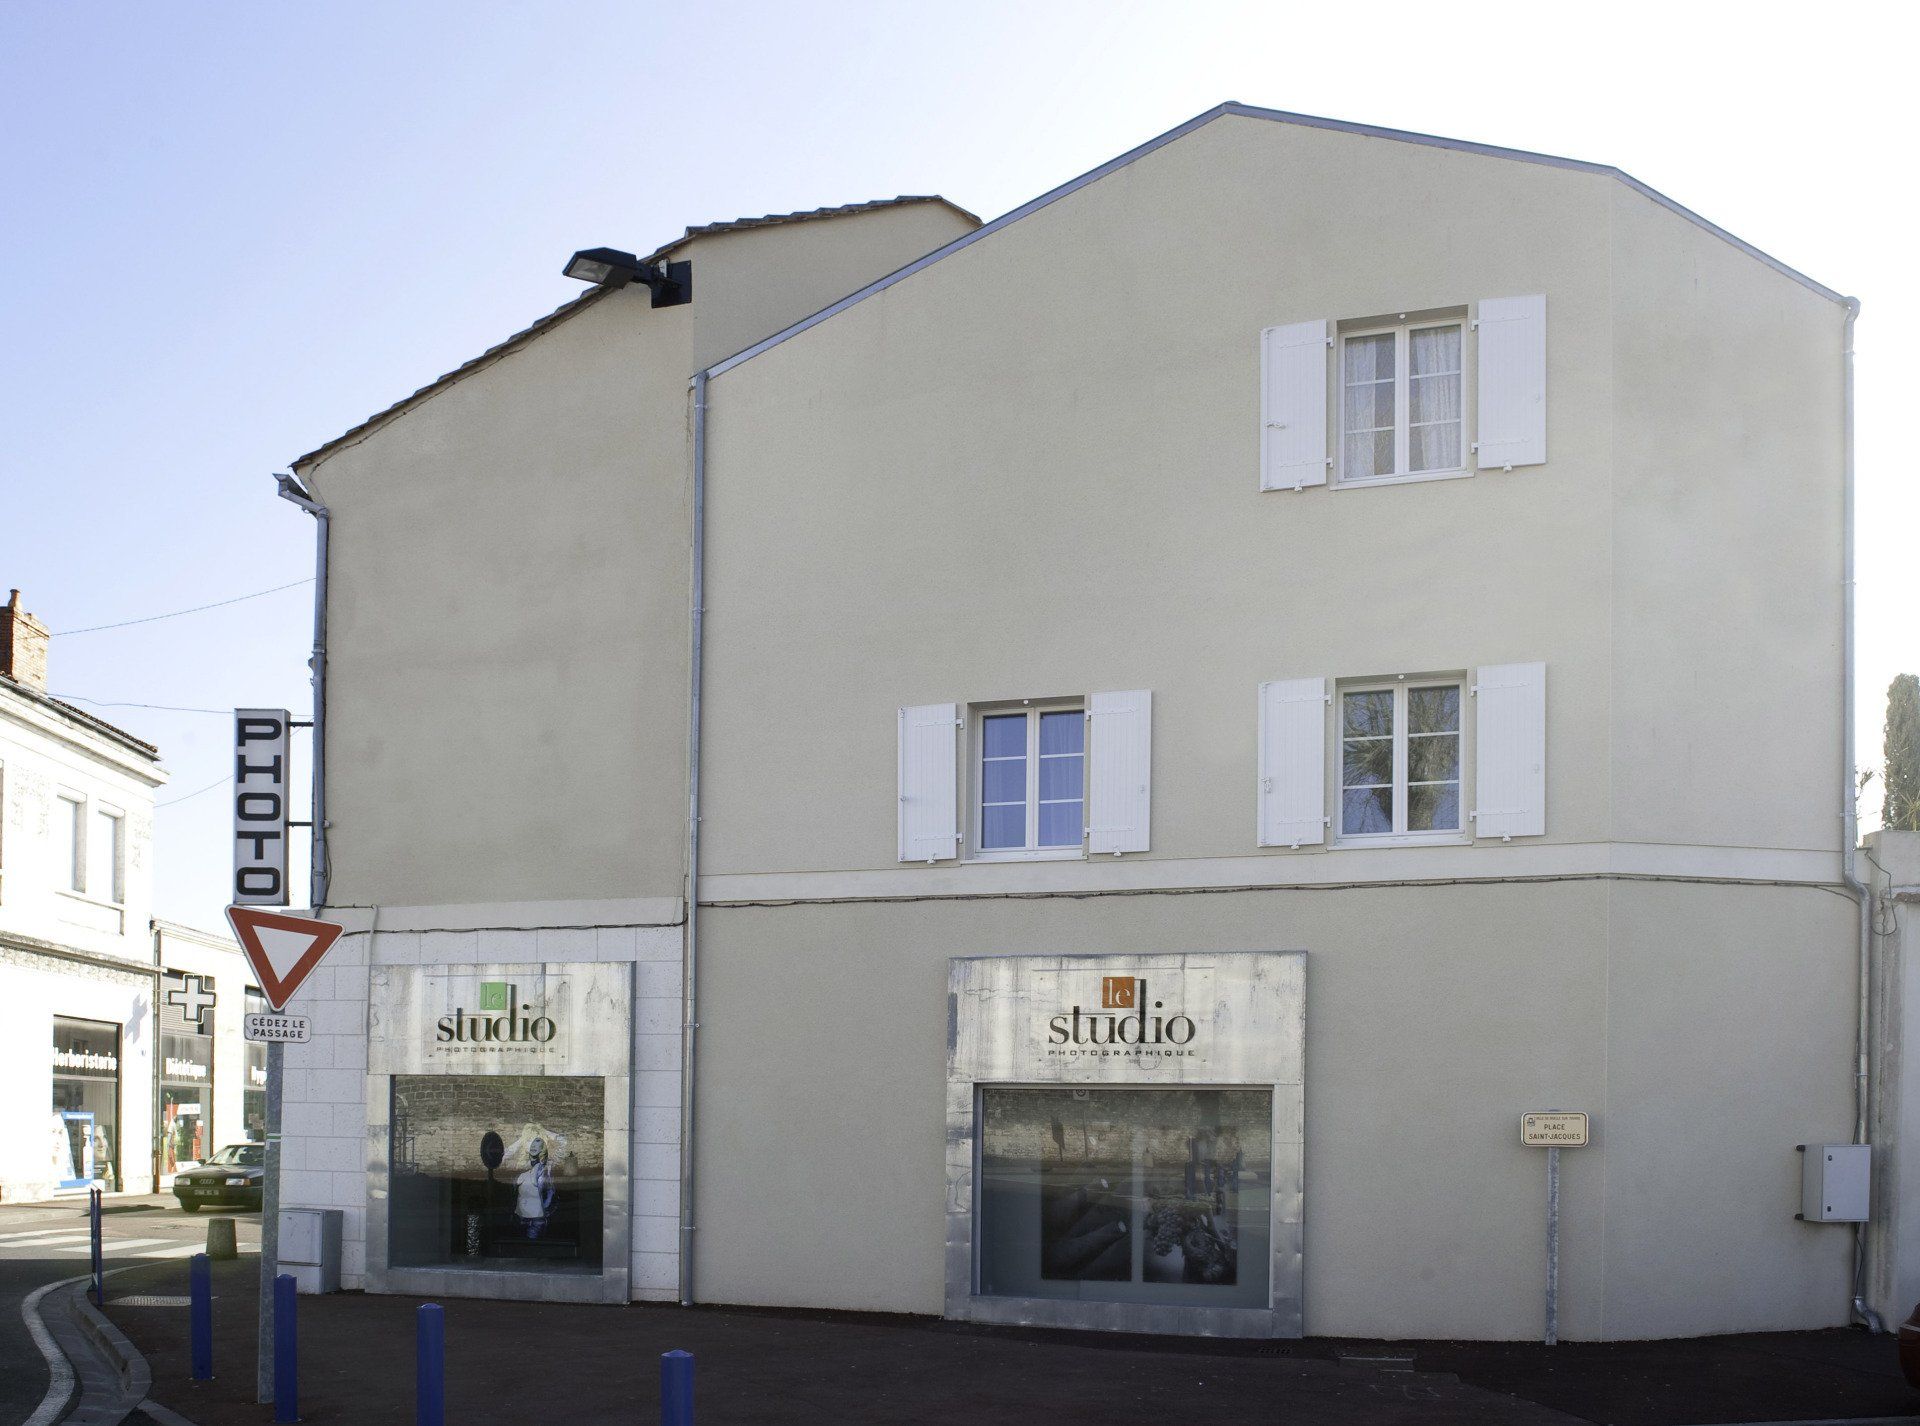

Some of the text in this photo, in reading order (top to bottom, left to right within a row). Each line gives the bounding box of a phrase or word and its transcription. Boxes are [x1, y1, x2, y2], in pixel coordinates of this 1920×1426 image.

[237, 718, 282, 896] PHOTO
[437, 984, 557, 1043] studio
[1048, 979, 1196, 1045] studio
[252, 1016, 305, 1029] CÉDEZ LE
[253, 1028, 304, 1039] PASSAGE
[436, 1046, 556, 1054] PHOTOGRAPHIQUE
[1048, 1049, 1195, 1057] PHOTOGRAPHIQUE
[51, 1046, 117, 1071] Herboristerie
[1543, 1123, 1566, 1131] PLACE
